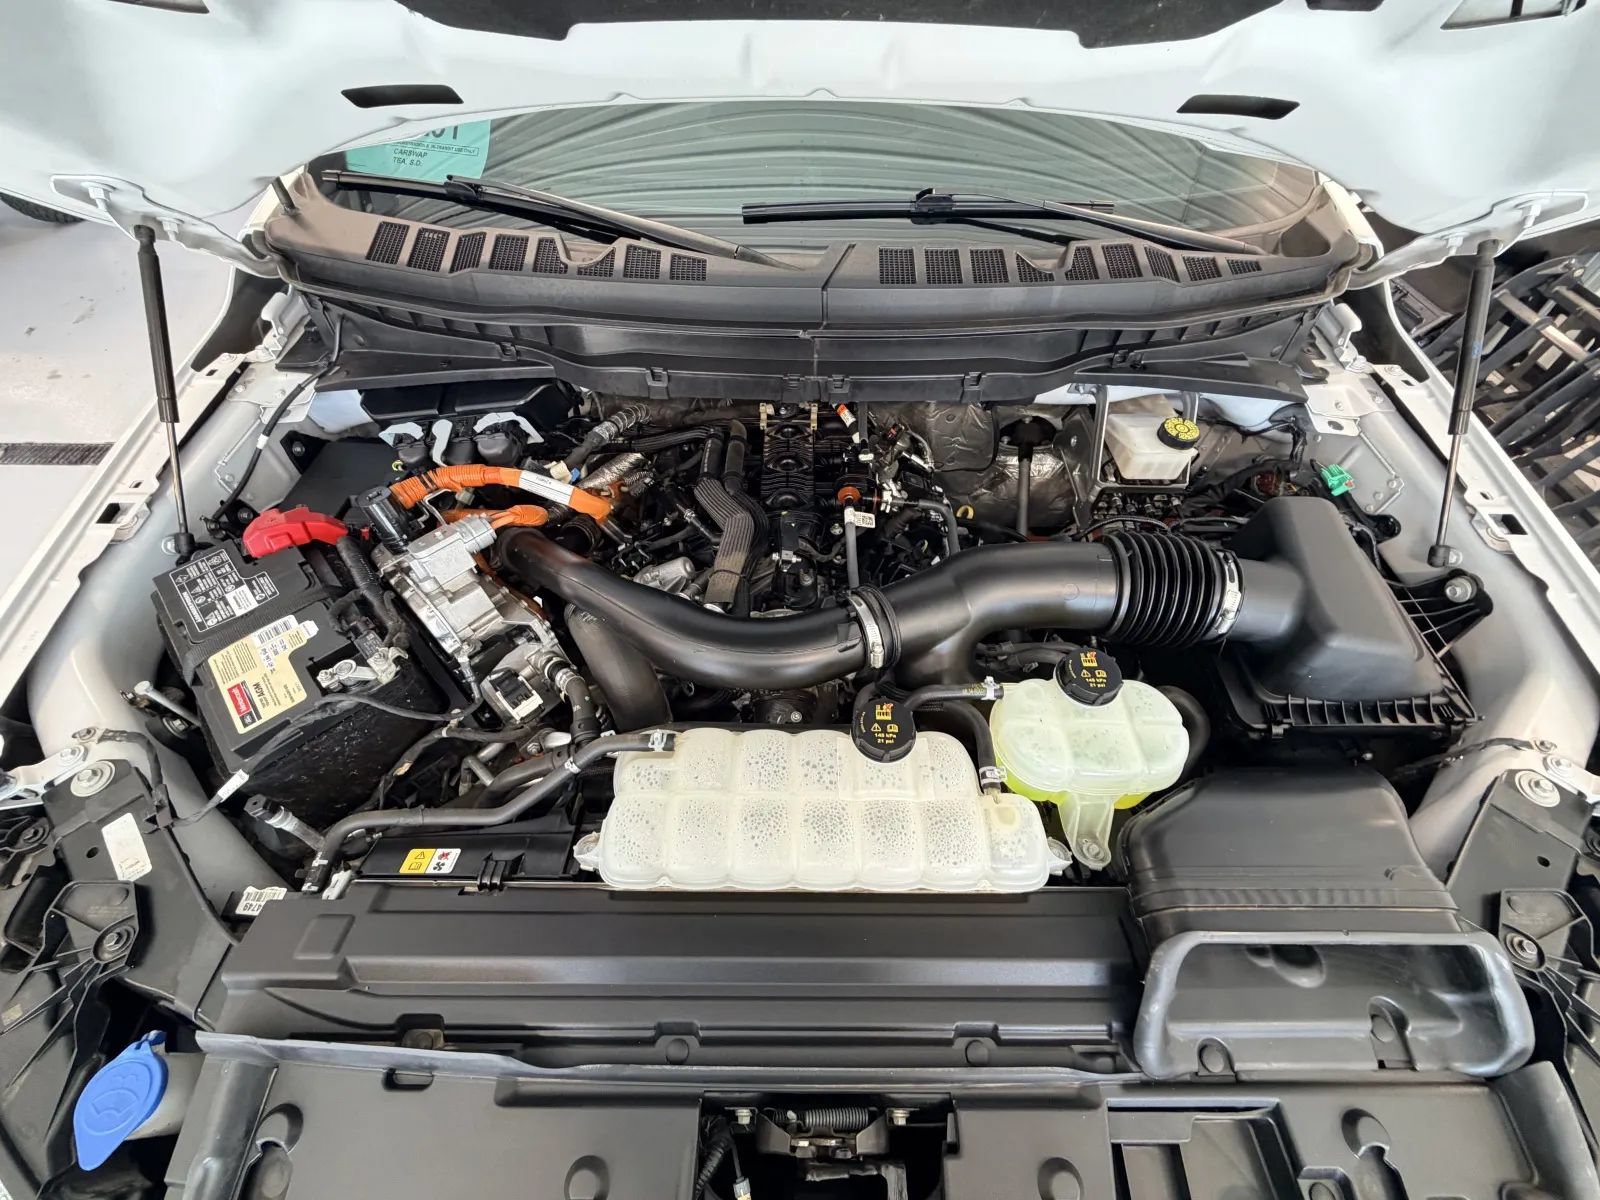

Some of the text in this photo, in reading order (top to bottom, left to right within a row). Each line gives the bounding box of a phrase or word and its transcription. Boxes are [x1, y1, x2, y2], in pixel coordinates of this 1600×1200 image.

[394, 148, 428, 158] CARSWAP
[253, 682, 265, 698] AGM
[243, 902, 262, 912] 4749
